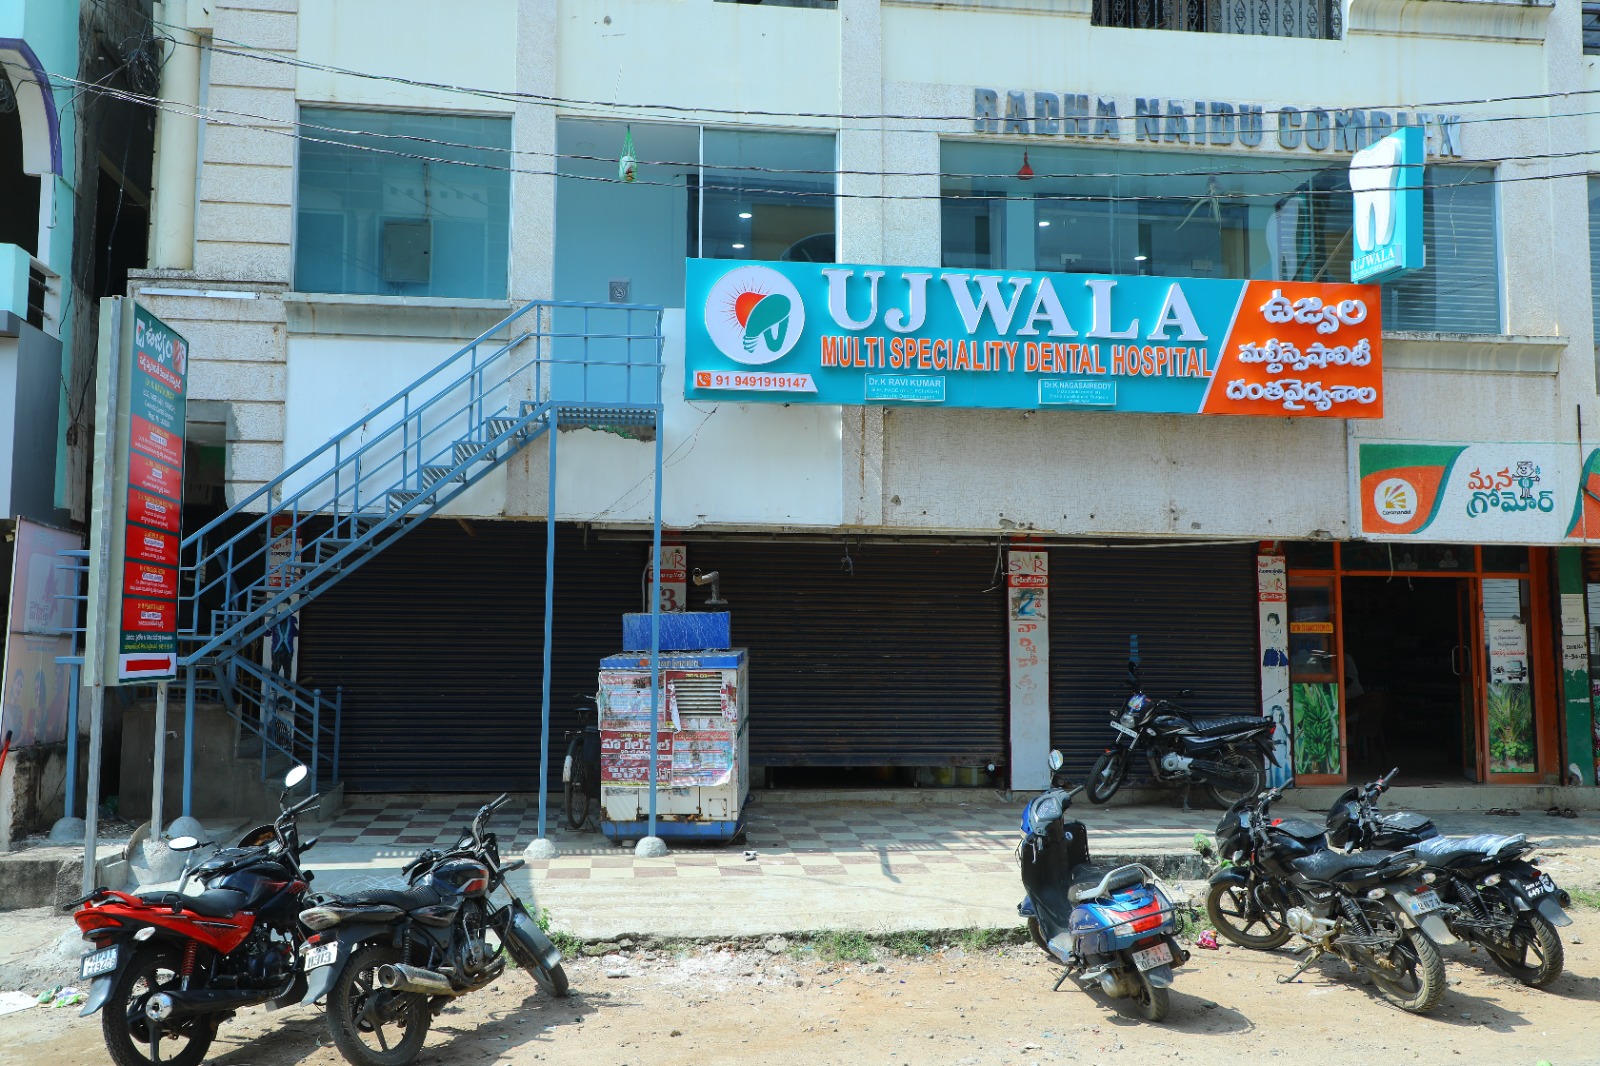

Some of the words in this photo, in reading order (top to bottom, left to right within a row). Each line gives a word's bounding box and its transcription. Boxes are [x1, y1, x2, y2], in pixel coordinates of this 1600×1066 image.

[974, 88, 1120, 139] RADHA
[1135, 97, 1263, 147] NAIDU
[1353, 247, 1396, 271] UJWALA
[821, 268, 1209, 341] UJWALA
[1260, 289, 1368, 334] ఉజ్వల
[820, 335, 886, 368] MULTI
[888, 337, 1020, 373] SPECIALITY
[1024, 341, 1107, 375] DENTAL
[1111, 344, 1213, 378] HOSPITAL
[715, 374, 730, 386] 91
[734, 374, 808, 388] 9491919147
[888, 378, 908, 386] RAVI
[910, 379, 941, 387] KUMAR
[1226, 378, 1377, 411] దంతవైద్యశాల
[1467, 466, 1513, 491] మన
[1466, 488, 1554, 518] గ్రోమోర్
